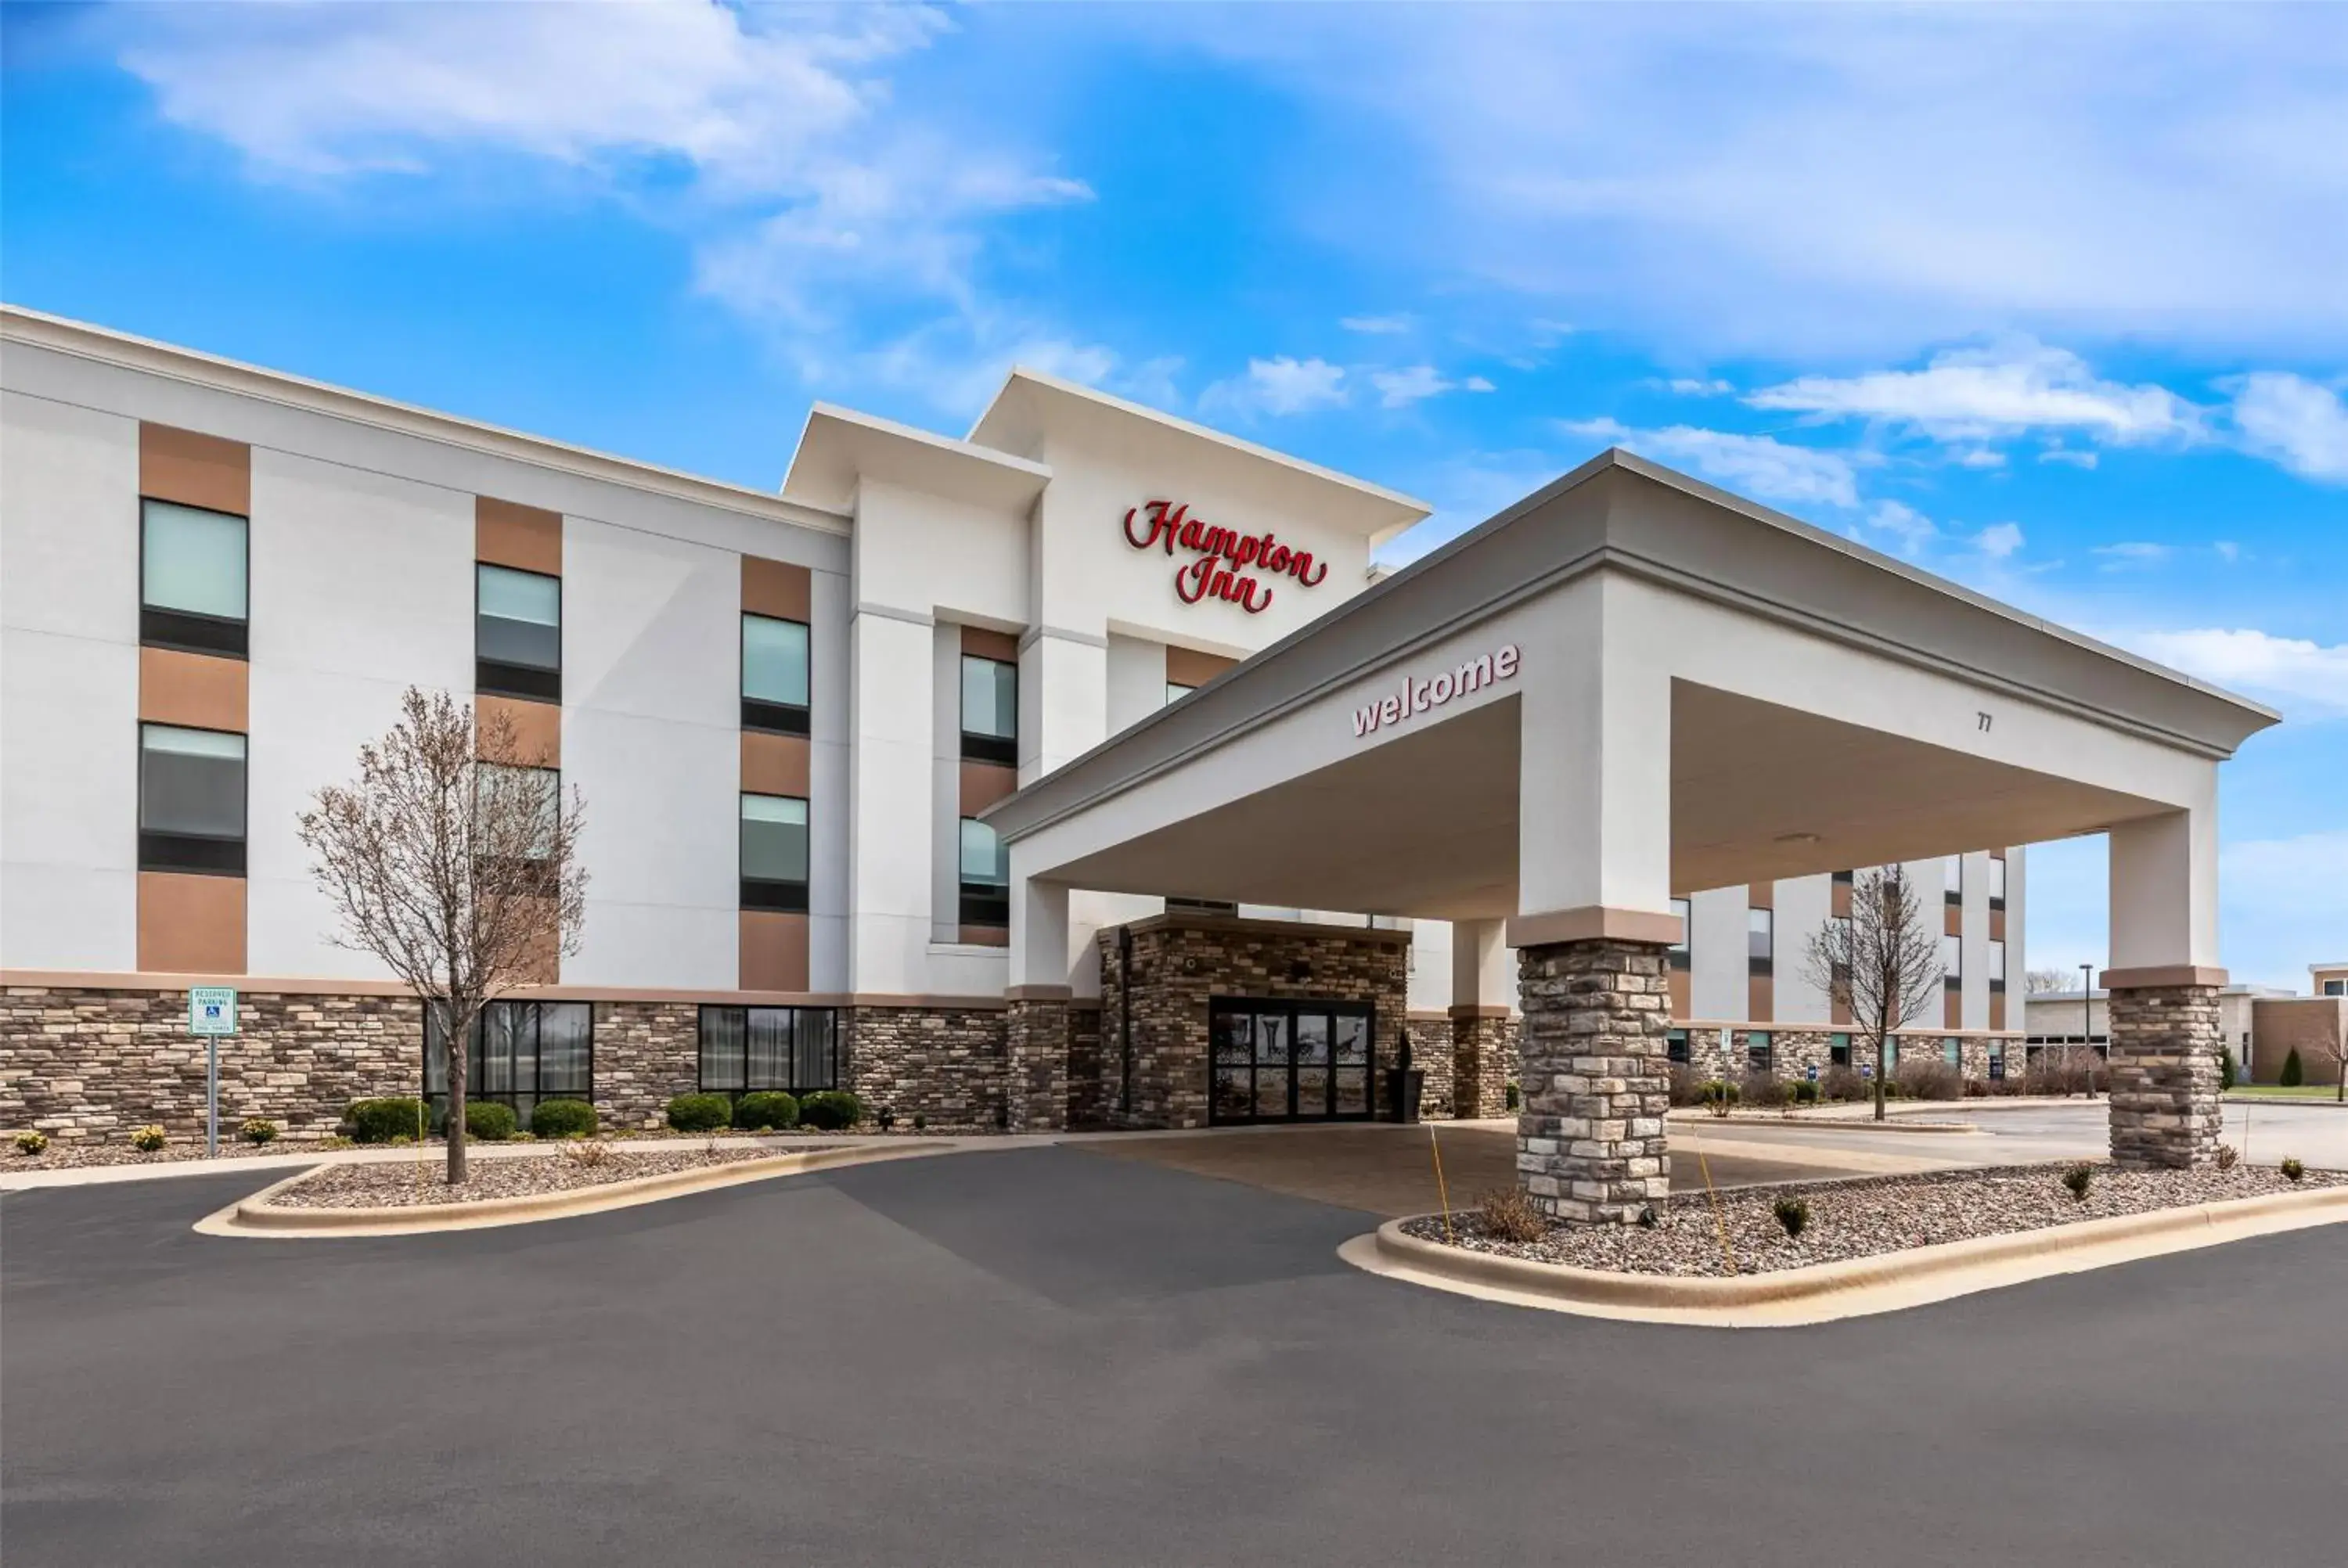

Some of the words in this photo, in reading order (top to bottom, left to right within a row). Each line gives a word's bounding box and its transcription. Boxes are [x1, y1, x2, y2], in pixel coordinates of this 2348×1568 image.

[1125, 501, 1327, 588] Hampton
[1176, 556, 1272, 613] Inn
[1350, 643, 1520, 737] welcome
[1978, 711, 1992, 732] 77
